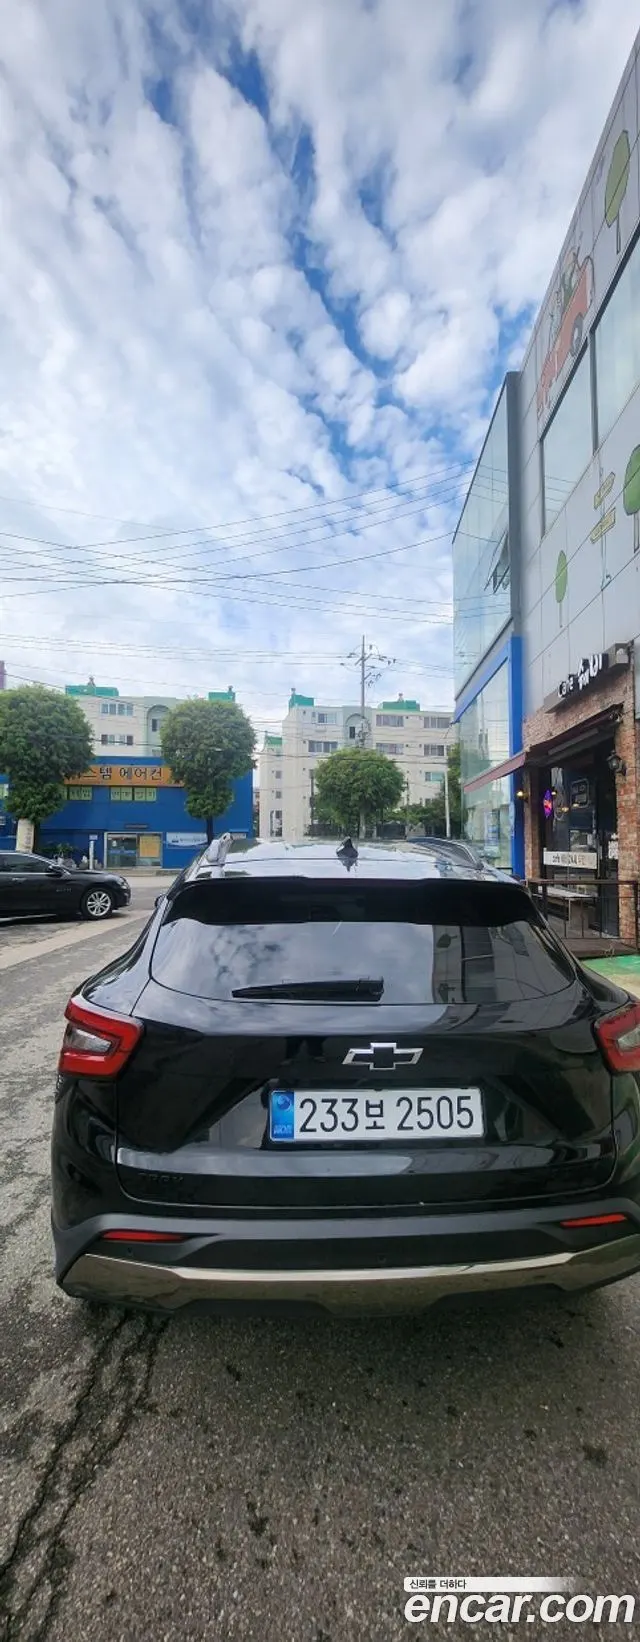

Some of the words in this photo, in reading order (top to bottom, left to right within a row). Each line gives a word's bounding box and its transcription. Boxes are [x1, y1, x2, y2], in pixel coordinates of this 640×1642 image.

[119, 767, 162, 781] 에어컨
[299, 1098, 385, 1133] 233보
[395, 1095, 474, 1131] 2505
